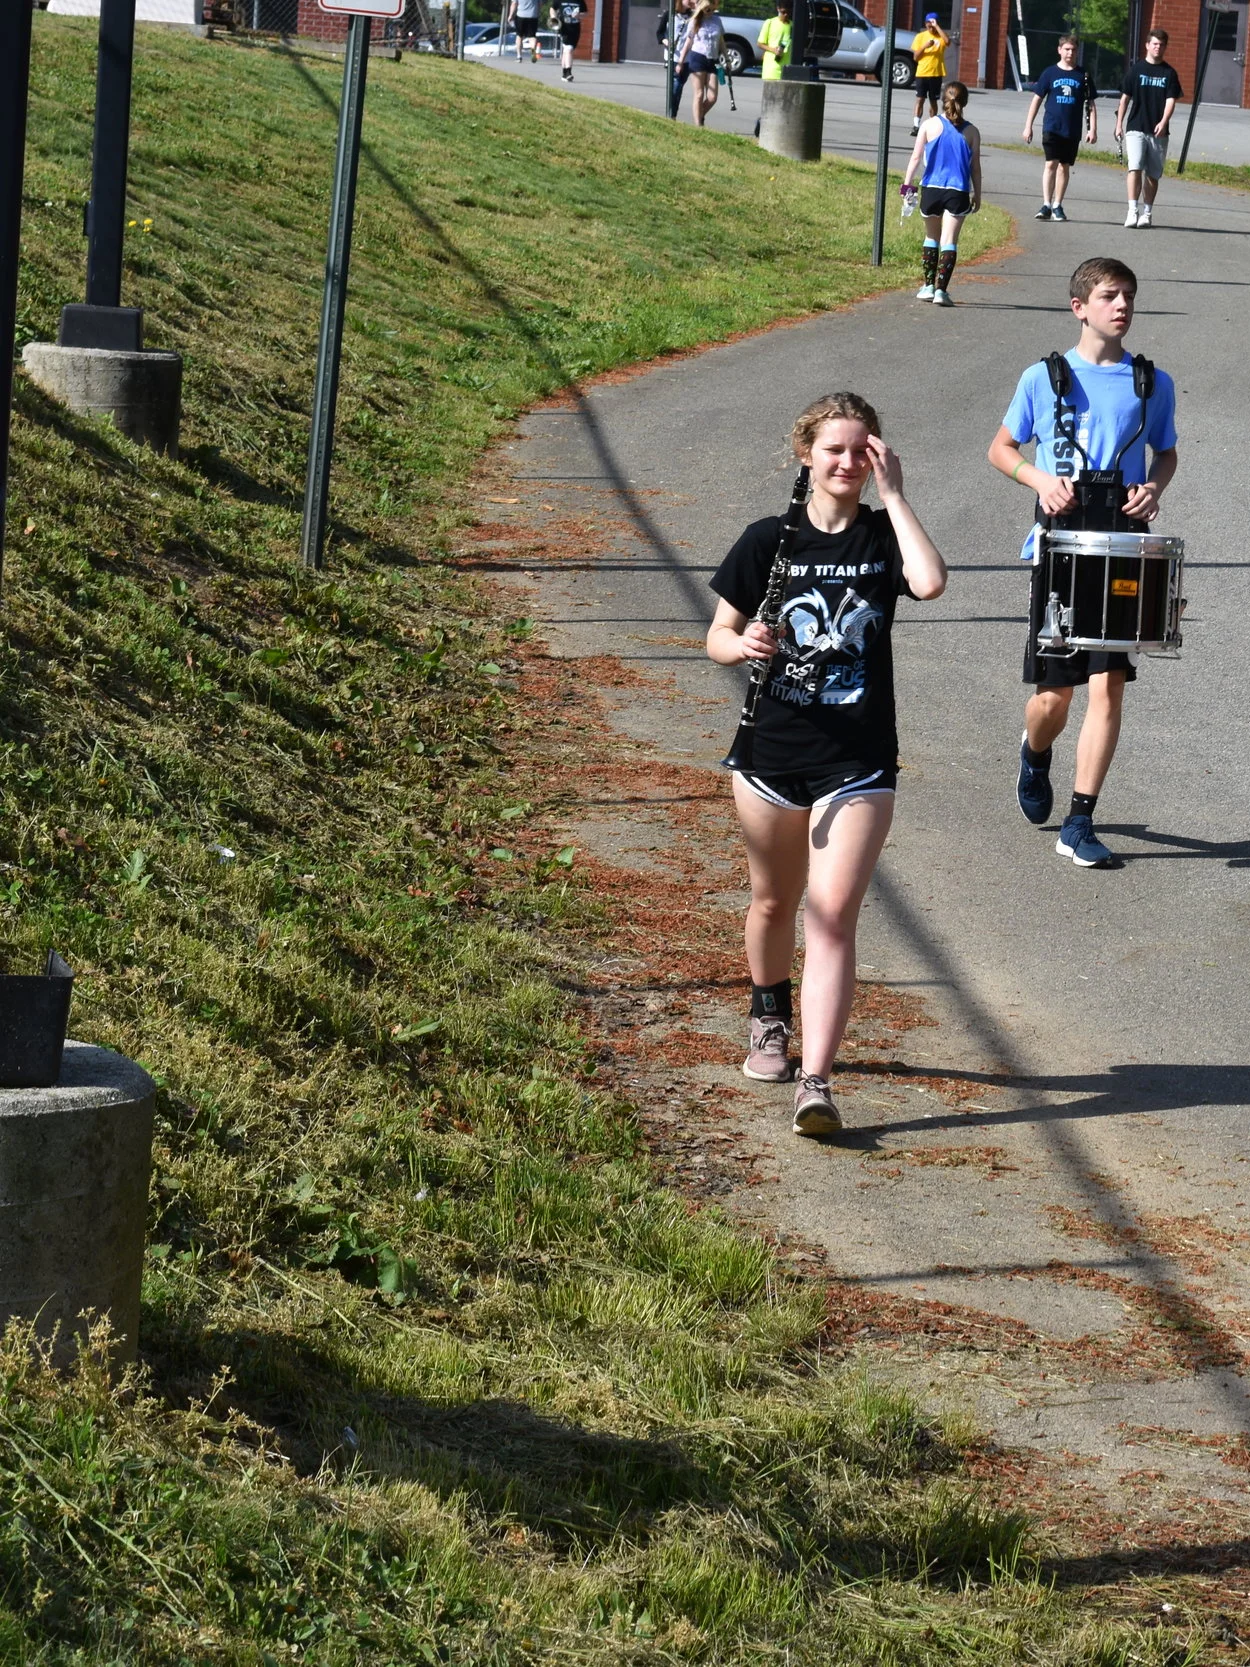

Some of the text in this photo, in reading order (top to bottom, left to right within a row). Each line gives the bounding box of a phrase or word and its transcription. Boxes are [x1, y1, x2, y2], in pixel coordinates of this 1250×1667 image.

[1053, 77, 1080, 89] COSBY
[1053, 400, 1077, 478] OSBY
[814, 564, 857, 577] TITAN
[770, 680, 815, 707] TITANS
